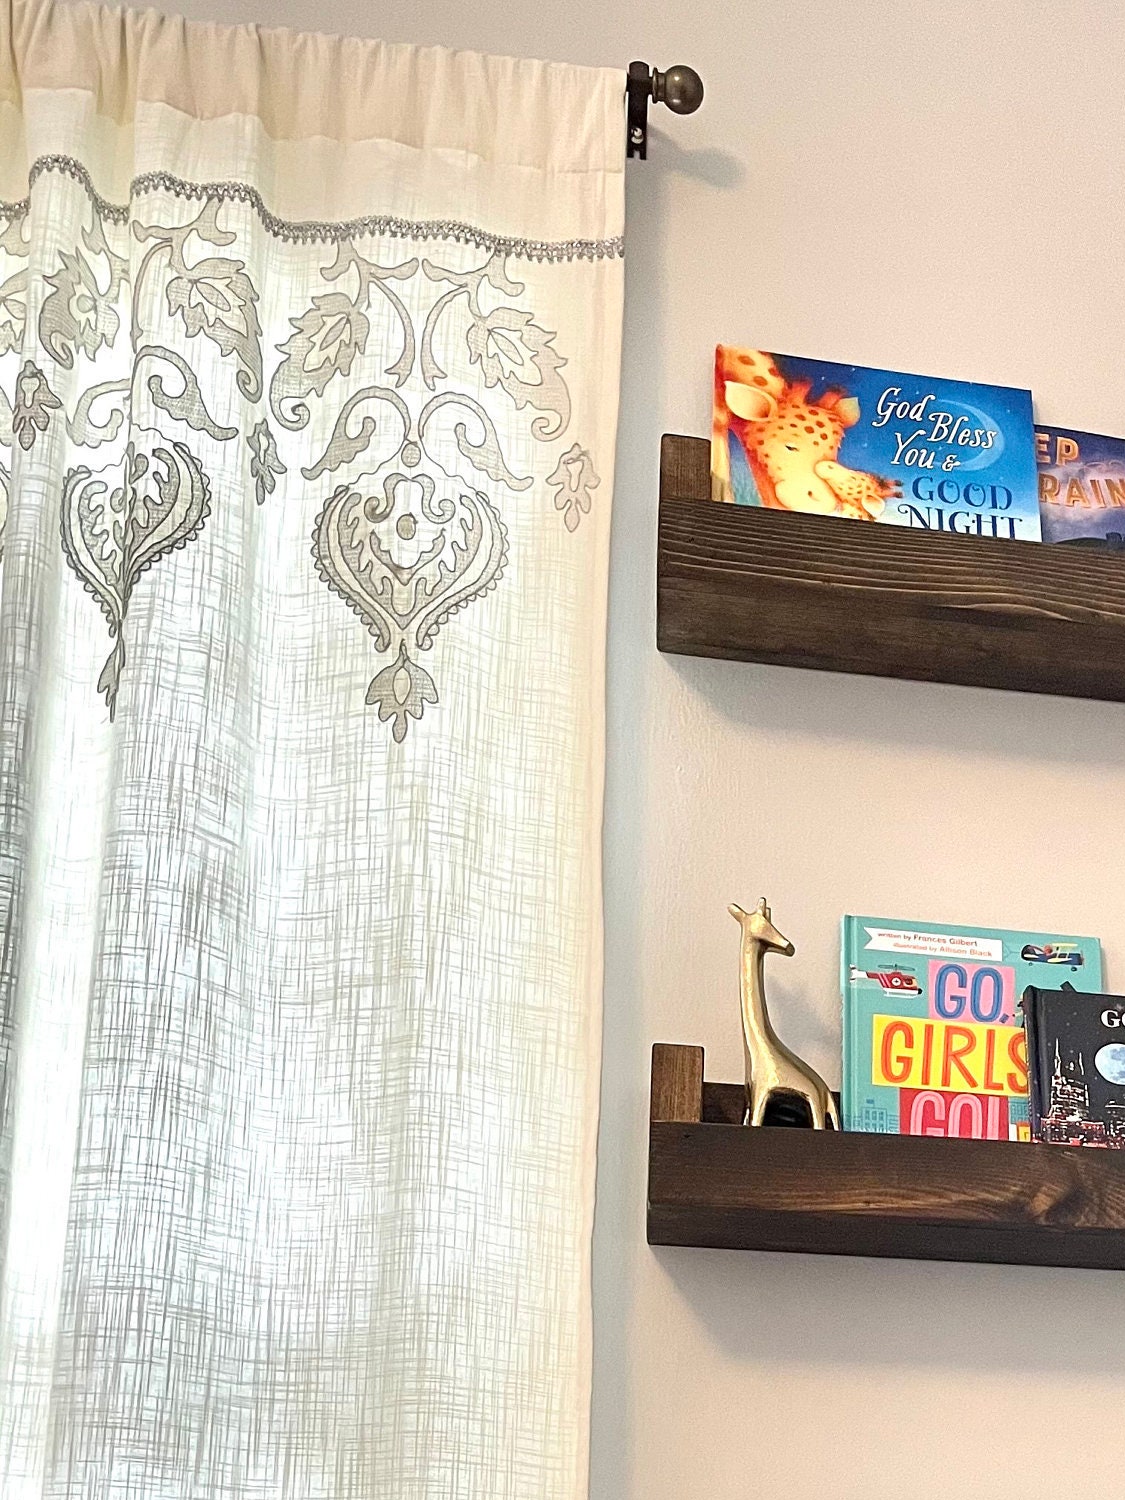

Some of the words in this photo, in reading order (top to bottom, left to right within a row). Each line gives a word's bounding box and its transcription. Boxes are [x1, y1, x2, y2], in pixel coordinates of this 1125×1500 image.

[872, 387, 935, 427] God
[928, 412, 998, 449] Bless
[890, 432, 934, 470] You
[942, 454, 961, 471] &
[911, 475, 1013, 511] GOOD
[898, 503, 1023, 540] NIGHT
[914, 933, 947, 944] Frances
[949, 938, 978, 947] Gilbert
[969, 949, 993, 957] Black
[935, 963, 1010, 1023] GO,
[881, 1021, 1028, 1091] GIRLS
